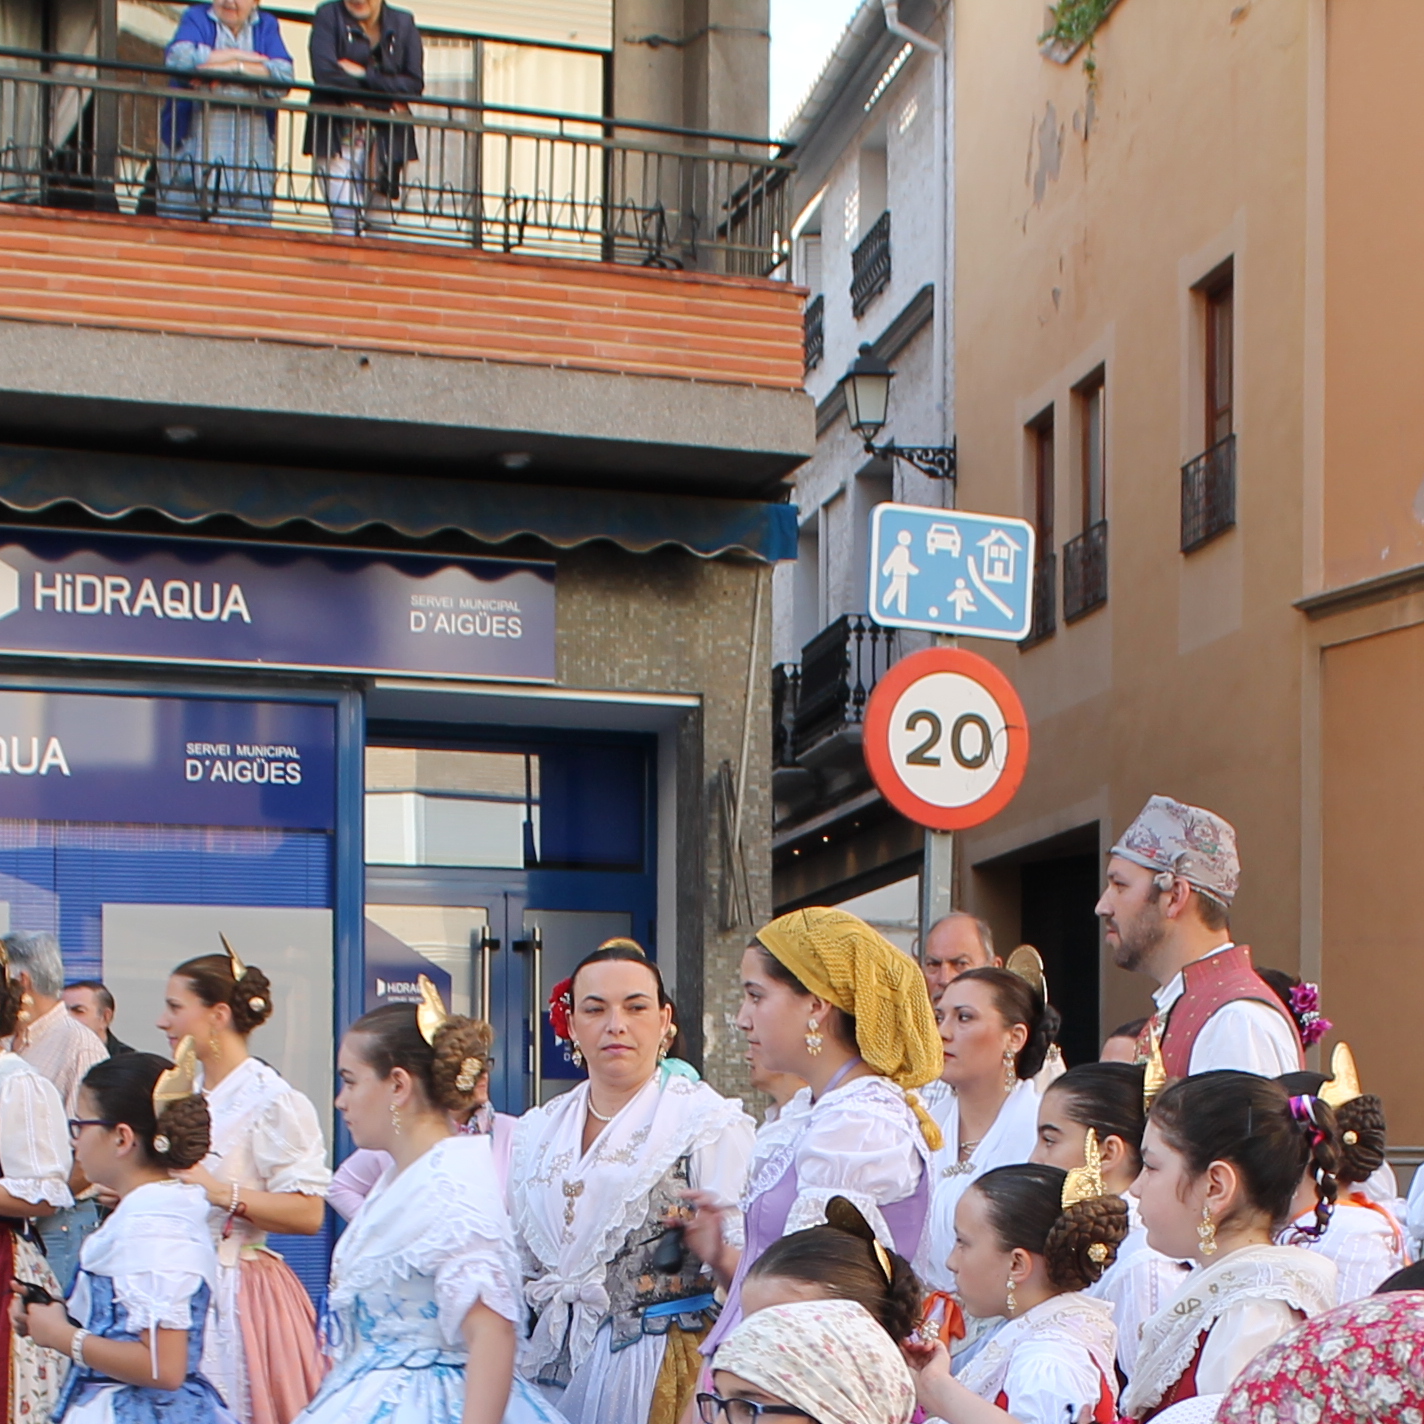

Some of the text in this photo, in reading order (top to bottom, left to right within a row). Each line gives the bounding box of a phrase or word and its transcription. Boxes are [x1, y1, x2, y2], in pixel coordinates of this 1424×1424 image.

[410, 594, 521, 613] SERVEI MUNICIPAL
[905, 710, 992, 769] 20
[185, 742, 301, 759] SERVEI MUNICIPAL
